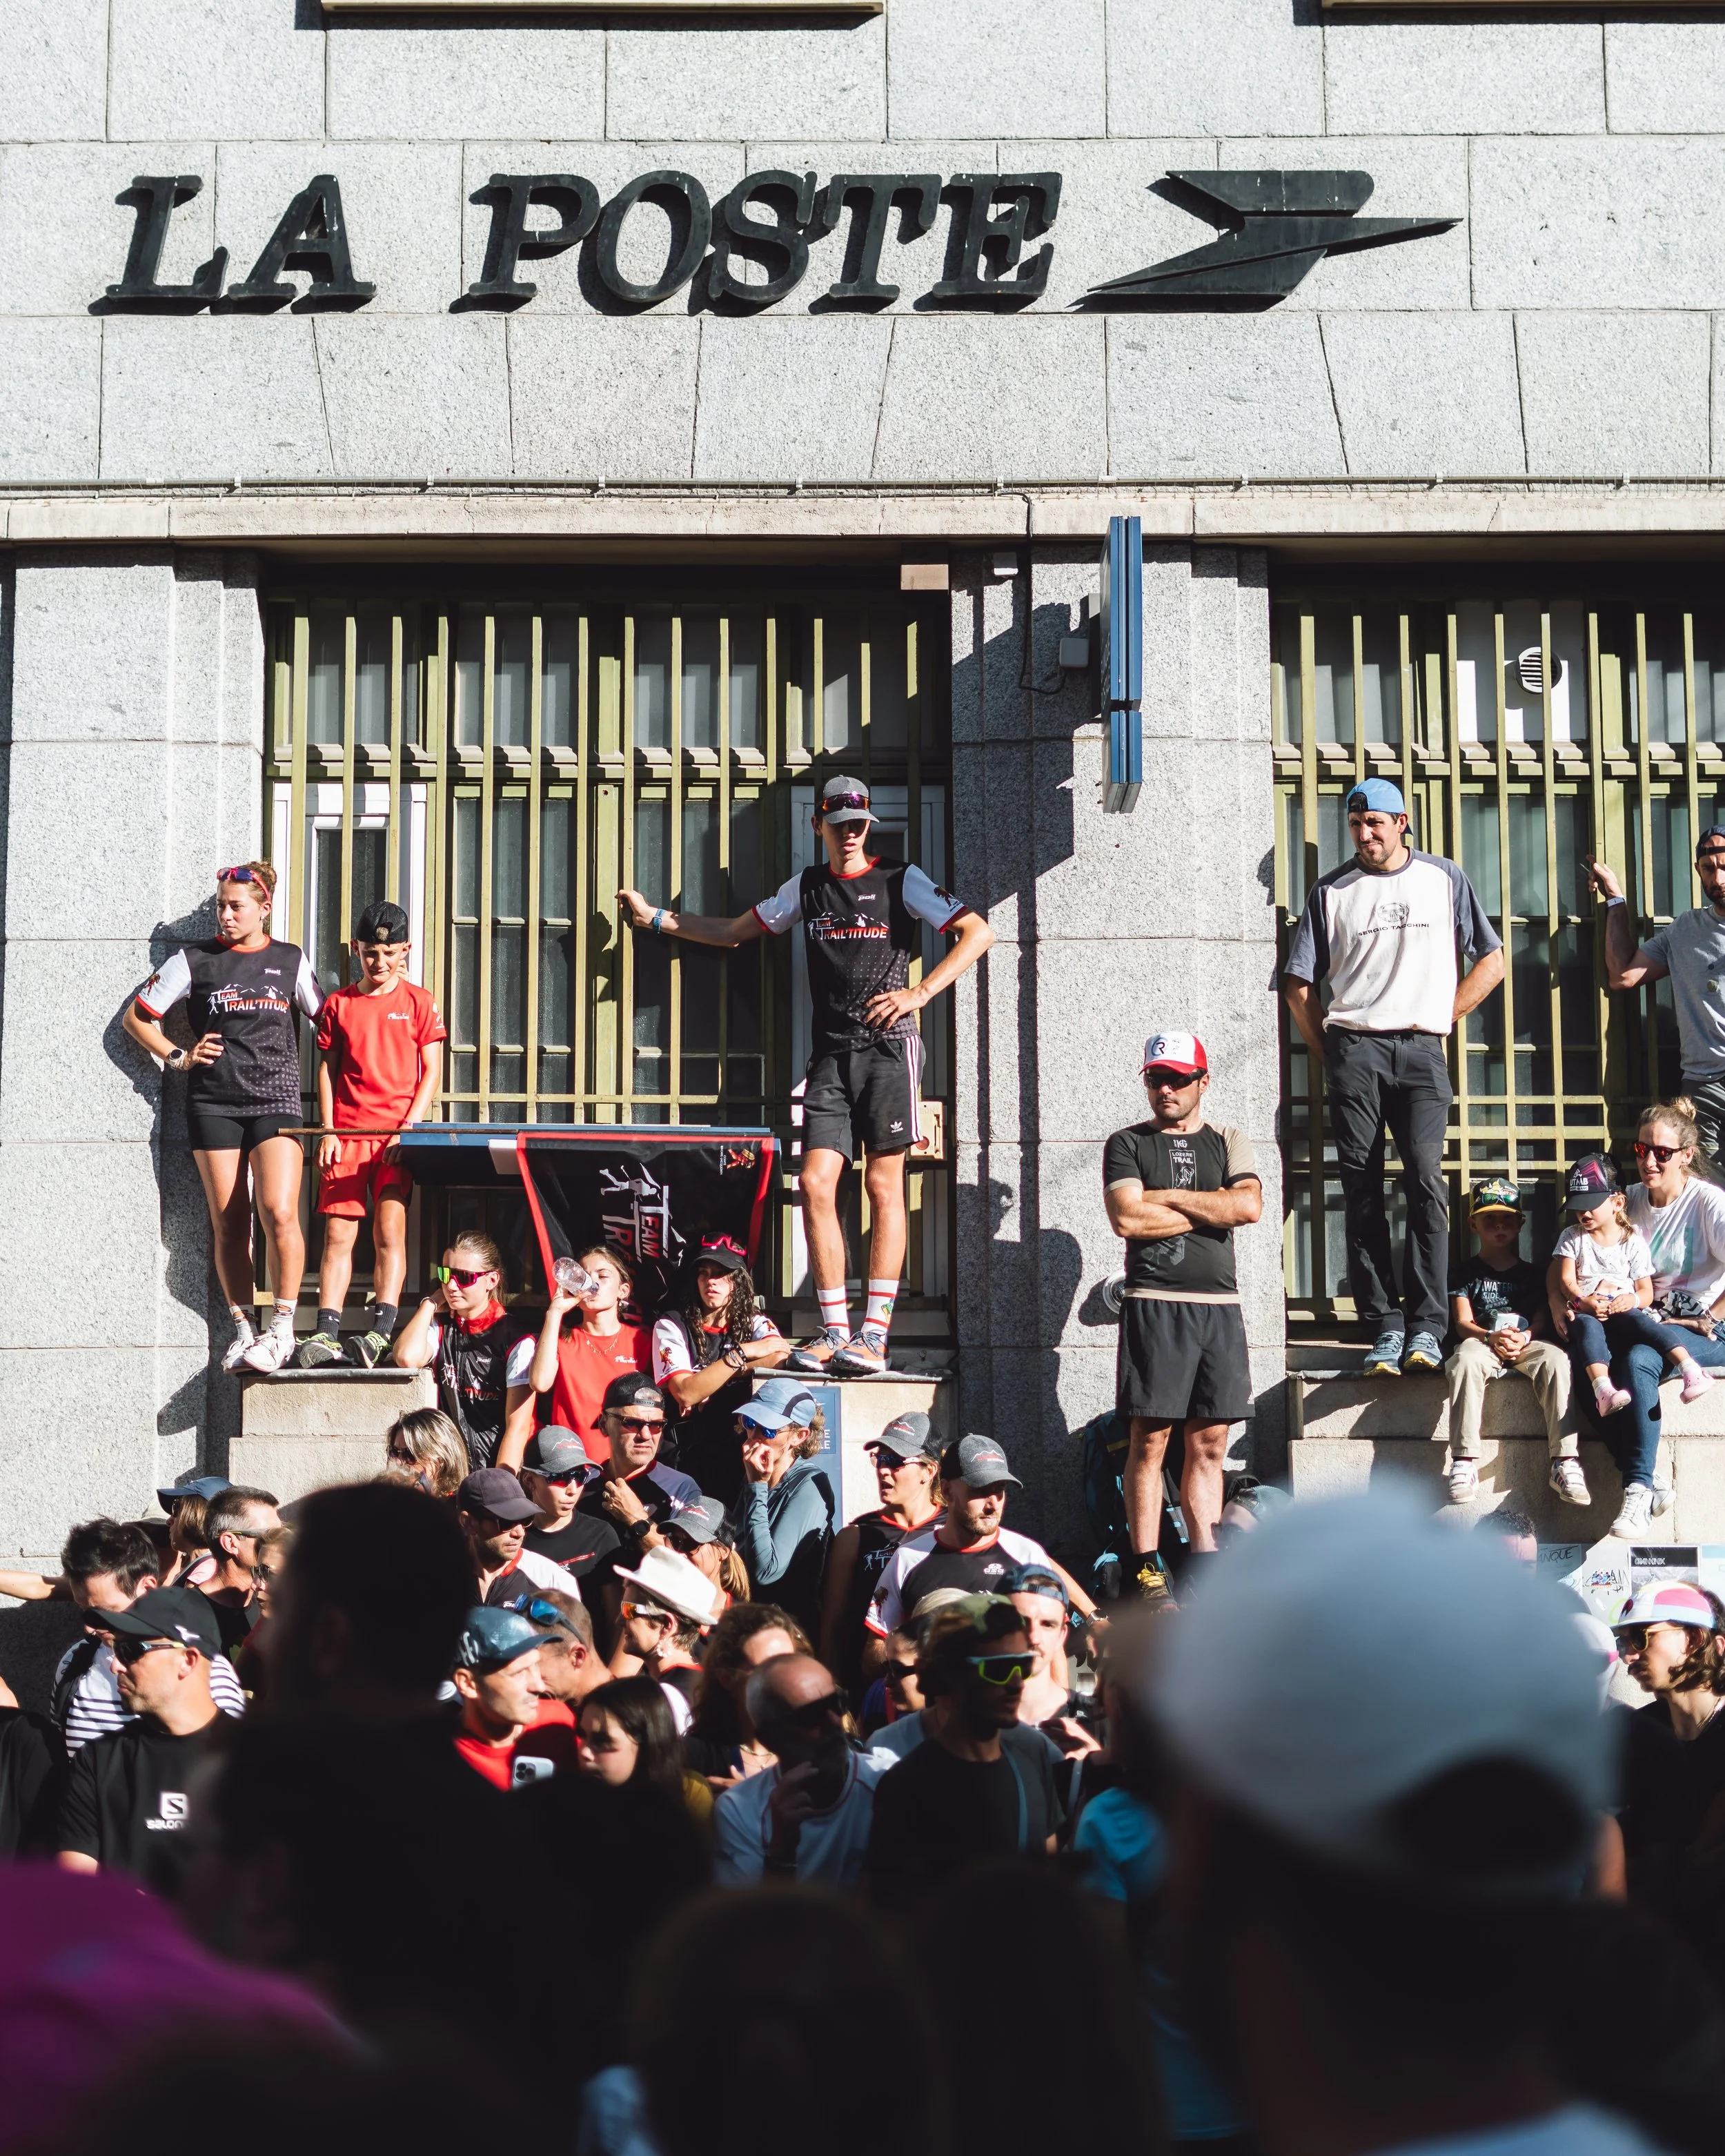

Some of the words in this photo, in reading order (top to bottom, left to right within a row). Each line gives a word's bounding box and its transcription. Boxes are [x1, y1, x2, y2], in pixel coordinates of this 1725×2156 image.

[106, 174, 377, 301] LA
[469, 170, 1063, 303] POSTE
[811, 918, 831, 928] TEAM
[816, 927, 889, 940] TRAIL'TITUDE
[1358, 927, 1388, 936] SERGIO
[211, 989, 238, 1000] TEAM
[217, 998, 289, 1013] TRAIL'TITUDE
[1570, 1177, 1588, 1186] UTMB
[639, 1185, 669, 1259] TEAM
[1483, 1280, 1512, 1292] WATER
